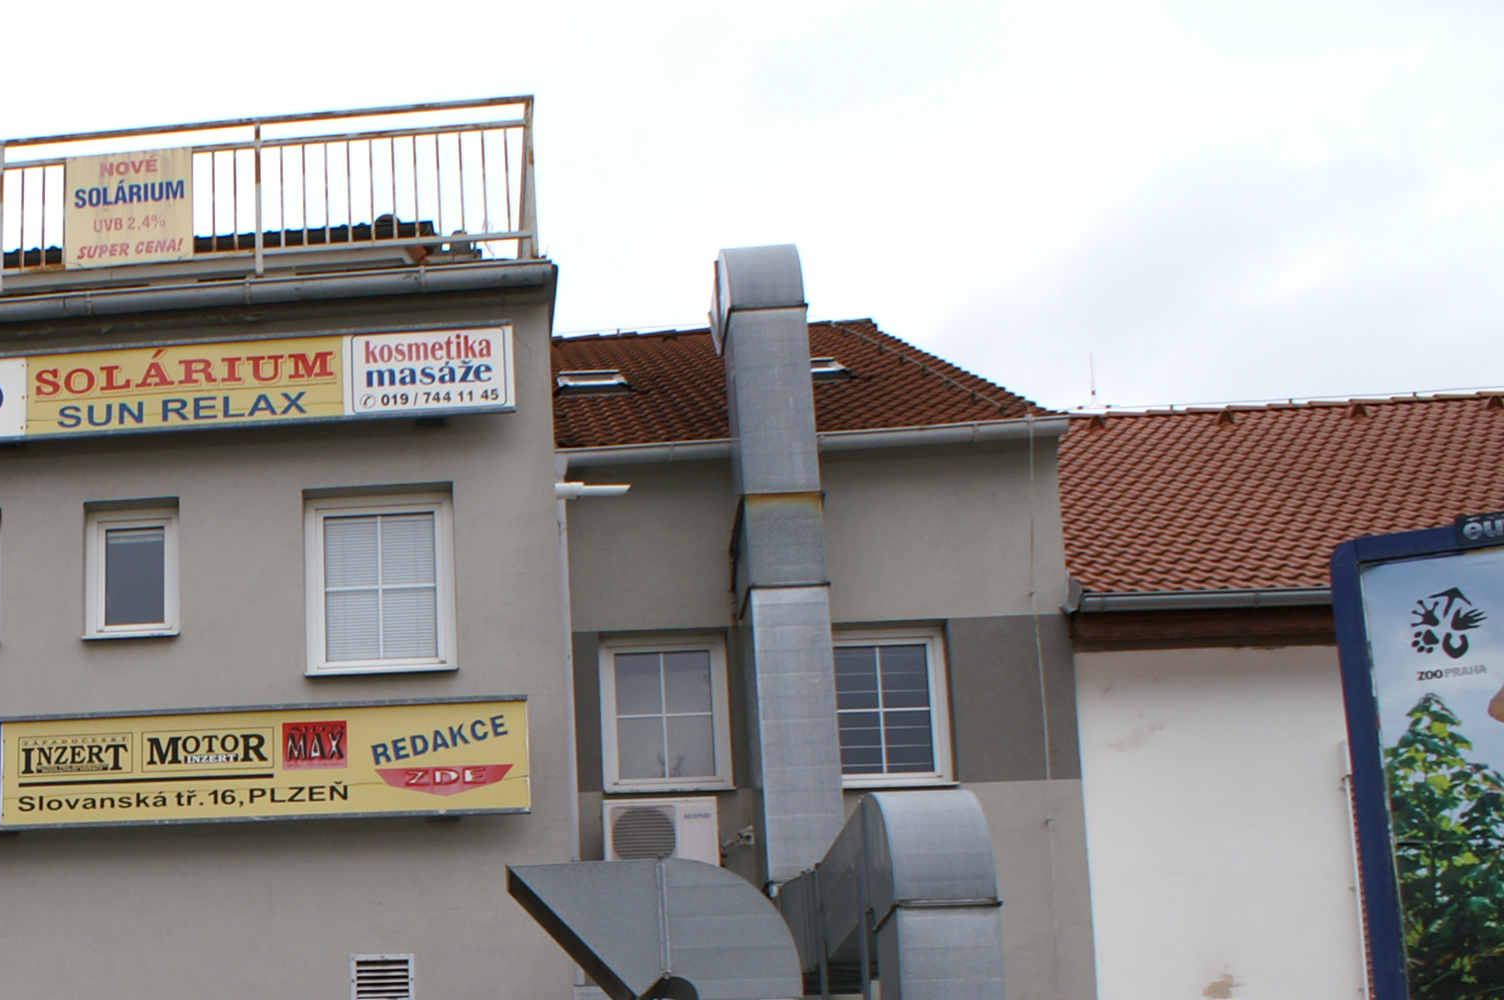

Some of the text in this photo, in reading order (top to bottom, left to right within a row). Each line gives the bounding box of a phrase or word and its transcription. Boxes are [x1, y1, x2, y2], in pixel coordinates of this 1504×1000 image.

[99, 155, 158, 177] NOVÉ
[74, 179, 185, 208] SOLÁRIUM
[93, 214, 167, 233] UVB 2,4%
[77, 237, 184, 260] SUPER CENA!
[365, 334, 492, 364] kosmetika
[35, 349, 335, 396] SOLÁRIUM
[366, 360, 493, 388] masáže
[57, 391, 308, 428] SUN RELAX
[381, 393, 409, 406] 019
[423, 391, 452, 404] 744
[458, 389, 474, 402] 11
[481, 388, 500, 401] 45
[1417, 664, 1488, 682] ZOO PRAHA
[147, 733, 268, 765] MOTOR
[287, 732, 345, 760] MAX
[371, 714, 508, 765] REDAKCE
[21, 744, 129, 774] INZERT
[186, 753, 236, 764] INZERT
[405, 767, 488, 787] ZDE
[18, 791, 168, 812] Slovanská
